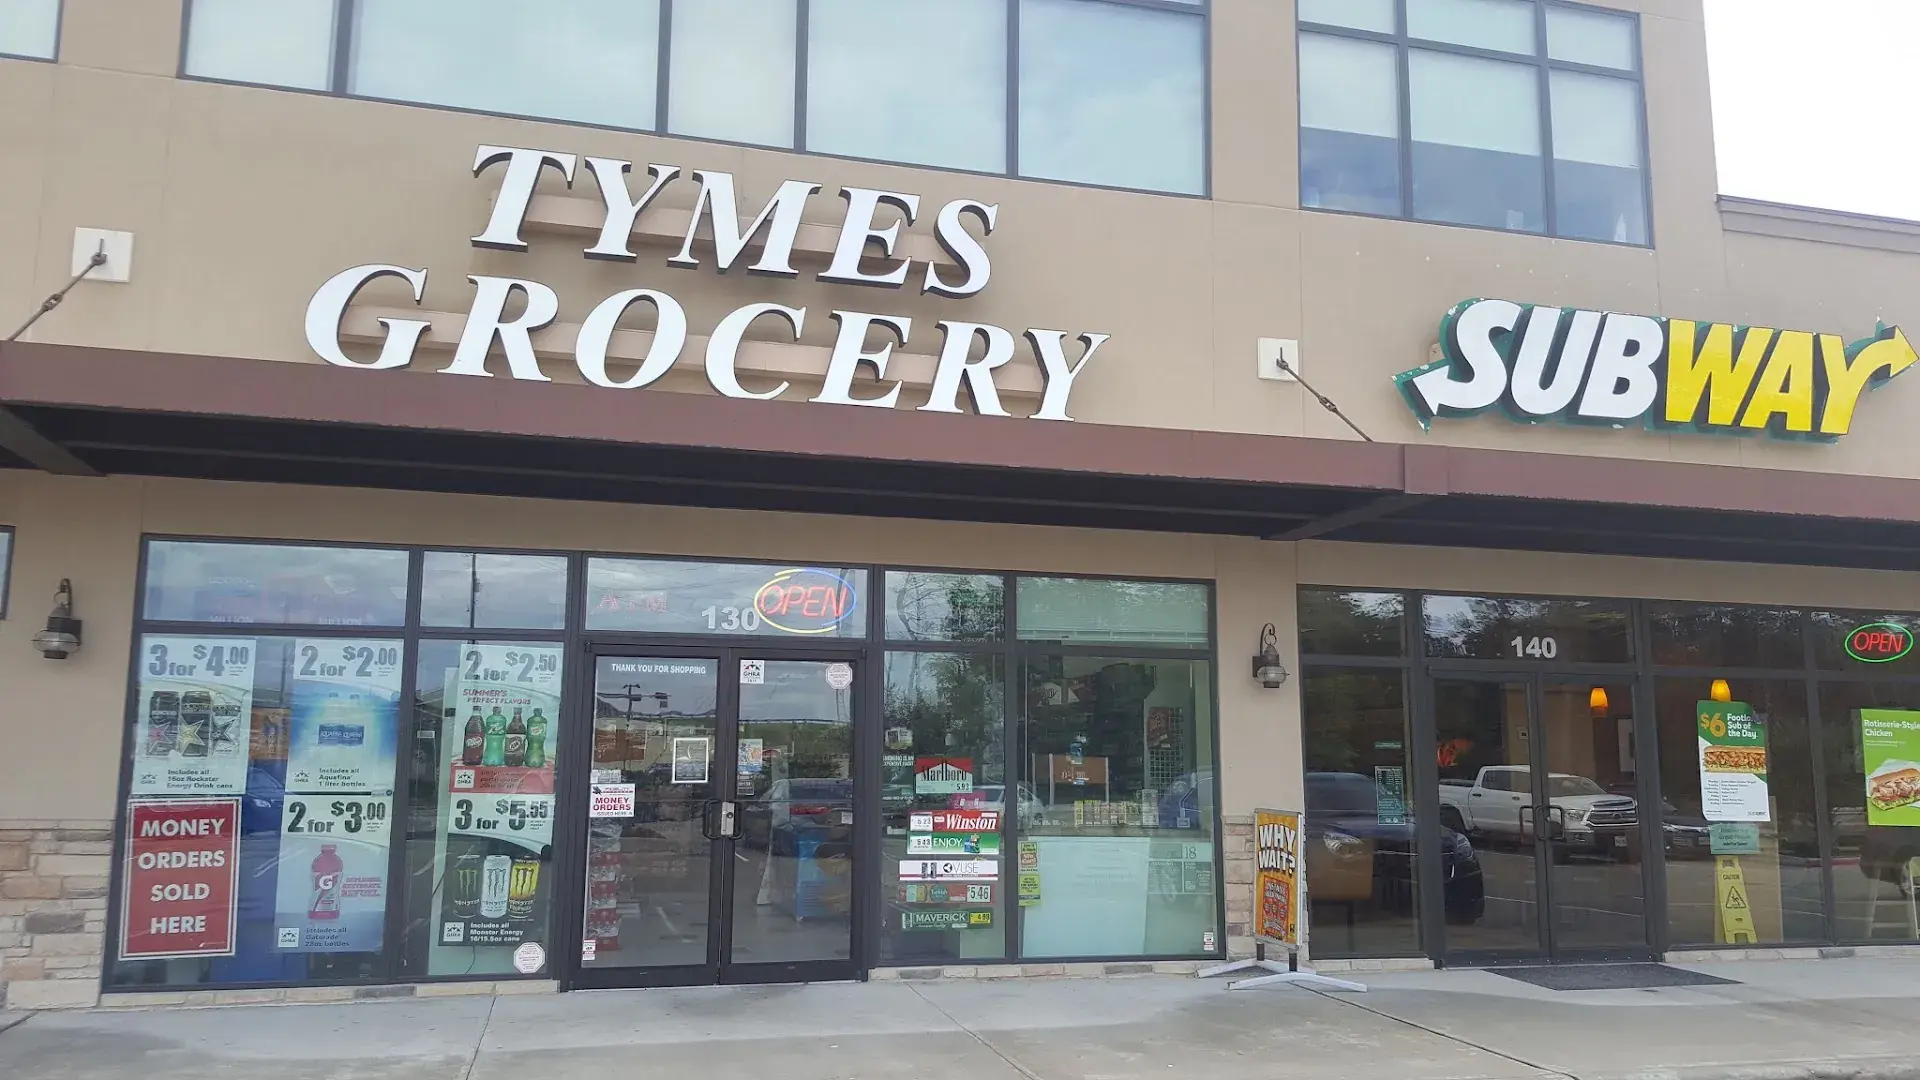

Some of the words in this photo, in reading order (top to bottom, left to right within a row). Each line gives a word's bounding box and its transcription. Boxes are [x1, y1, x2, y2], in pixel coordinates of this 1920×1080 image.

[471, 144, 1000, 300] TYMES
[305, 263, 1111, 421] GROCERY
[1413, 300, 1920, 436] SUBWAY
[759, 584, 848, 618] OPEN
[701, 605, 760, 631] 130
[1510, 635, 1557, 659] 140
[1853, 631, 1904, 652] OPEN
[148, 644, 168, 676] 3
[169, 662, 197, 676] for
[193, 644, 249, 677] $4.00
[300, 645, 319, 676] 2
[320, 662, 347, 676] for
[342, 646, 398, 677] $2.00
[464, 650, 483, 680] 2
[484, 668, 510, 682] for
[505, 652, 558, 683] $2.50
[612, 663, 636, 672] THANK
[638, 664, 652, 673] YOU
[654, 664, 669, 673] FOR
[670, 665, 706, 674] SHOPPING
[1700, 712, 1726, 738] $6
[1727, 722, 1742, 730] Sub
[1743, 722, 1752, 730] of
[1864, 729, 1893, 738] Chicken
[921, 760, 968, 782] Marlboro
[287, 801, 306, 833] 2
[307, 819, 335, 833] for
[330, 800, 386, 834] $3.00
[454, 798, 473, 830] 3
[476, 818, 500, 830] for
[496, 798, 548, 831] $5.55
[946, 814, 997, 830] Winston
[140, 818, 225, 838] MONEY
[1259, 824, 1296, 853] WHY
[138, 850, 225, 870] ORDERS
[1184, 846, 1197, 860] 18
[1258, 849, 1296, 876] WAIT?
[952, 862, 979, 874] VUSE
[150, 883, 210, 902] SOLD
[318, 875, 333, 890] G
[150, 916, 207, 935] HERE
[916, 912, 966, 922] MAVERICK
